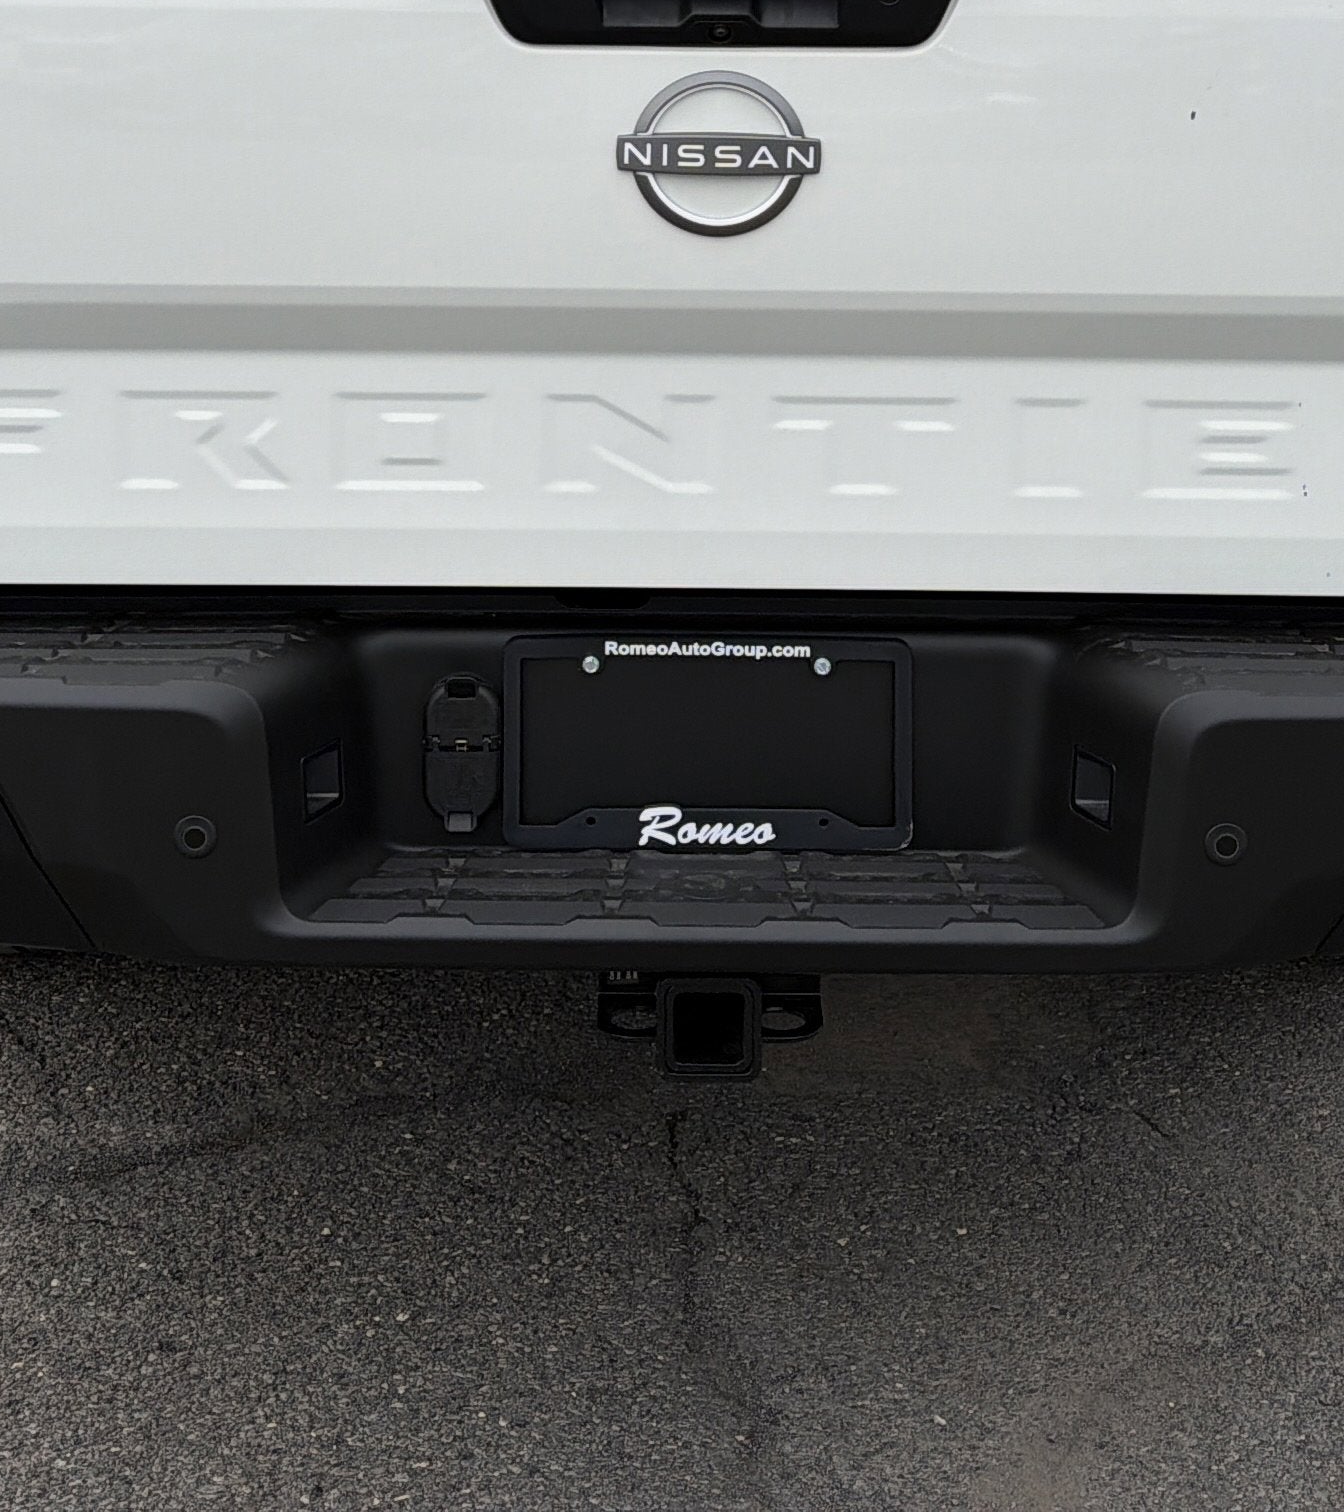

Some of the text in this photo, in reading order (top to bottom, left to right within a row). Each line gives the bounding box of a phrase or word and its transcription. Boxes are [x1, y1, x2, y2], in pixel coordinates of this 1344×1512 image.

[623, 142, 815, 169] NISSAN
[605, 641, 811, 660] RomeoAutoGroup.com
[638, 806, 776, 846] Romeo
